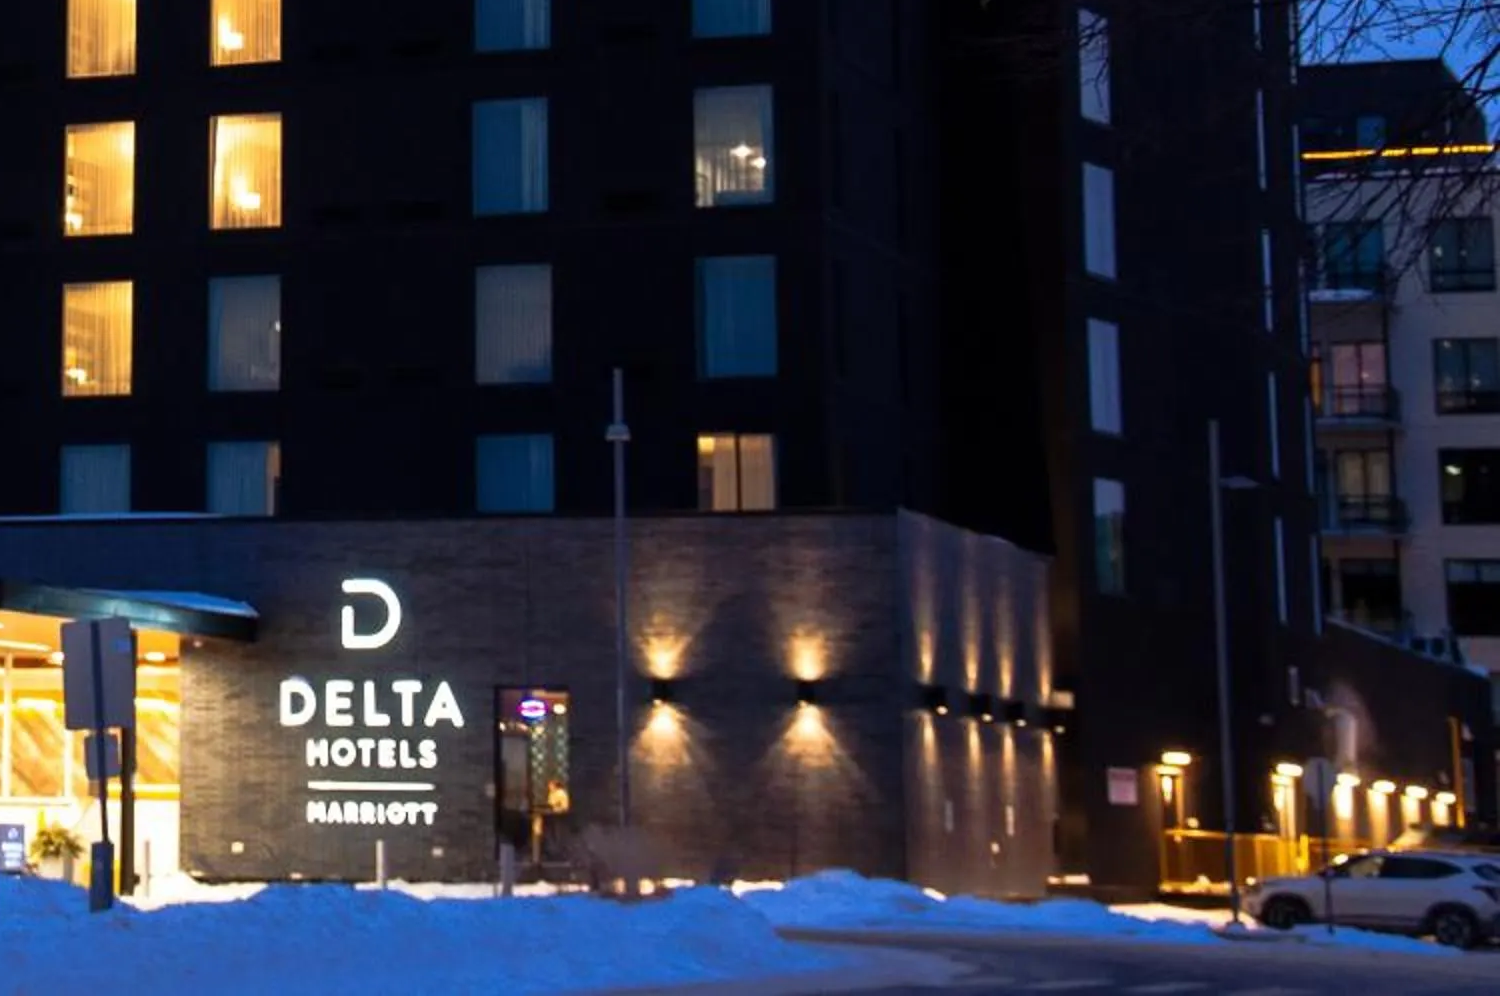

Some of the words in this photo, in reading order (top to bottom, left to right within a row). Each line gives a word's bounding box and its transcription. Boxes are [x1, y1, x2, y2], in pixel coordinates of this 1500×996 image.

[341, 578, 402, 649] D
[279, 678, 465, 728] DELTA
[305, 738, 439, 769] HOTELS
[306, 800, 439, 826] MARRIOTT
